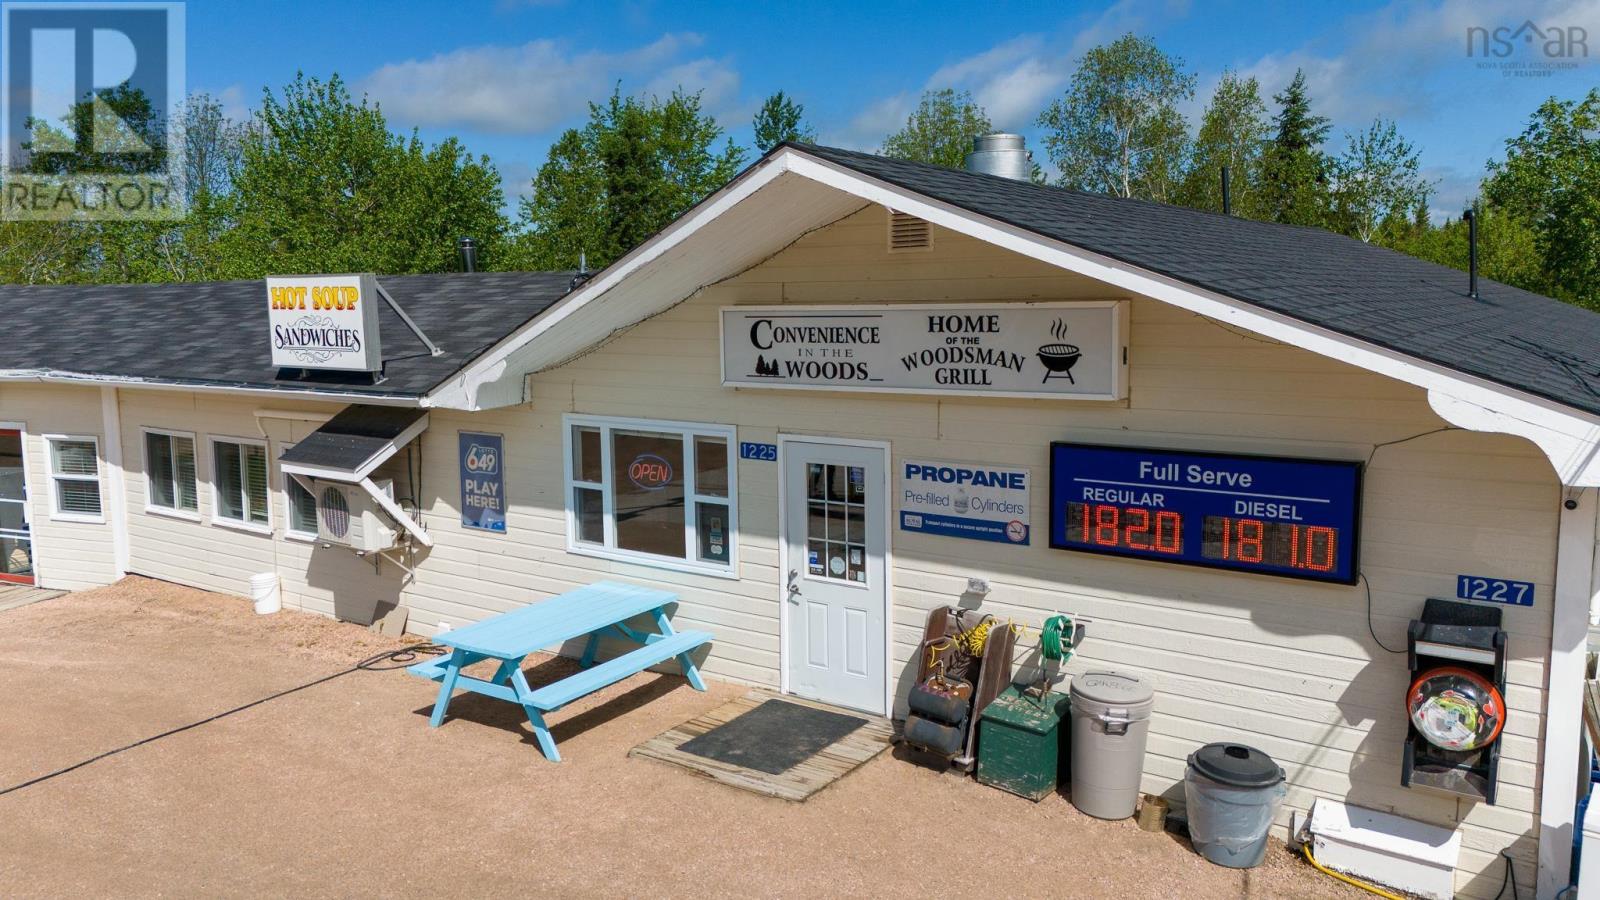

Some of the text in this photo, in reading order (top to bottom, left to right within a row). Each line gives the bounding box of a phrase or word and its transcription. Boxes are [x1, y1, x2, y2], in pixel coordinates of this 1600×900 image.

[271, 286, 359, 310] HOT SOUP
[927, 315, 1000, 333] HOME
[945, 337, 980, 345] OF THE
[798, 348, 854, 358] IN THE
[901, 346, 1026, 373] WOODSMAN
[785, 361, 869, 380] WOODS
[935, 367, 992, 385] GRILL
[467, 446, 496, 471] 649
[742, 443, 776, 460] 1225
[631, 463, 668, 482] OPEN
[905, 463, 1026, 490] PROPANE
[1140, 461, 1252, 488] Full Serve
[465, 479, 498, 496] PLAY
[1083, 486, 1165, 507] REGULAR
[466, 495, 500, 510] HERE!
[905, 490, 1024, 515] Pre-filled Cylinders
[1234, 500, 1303, 520] DIESEL
[1463, 578, 1528, 603] 1227
